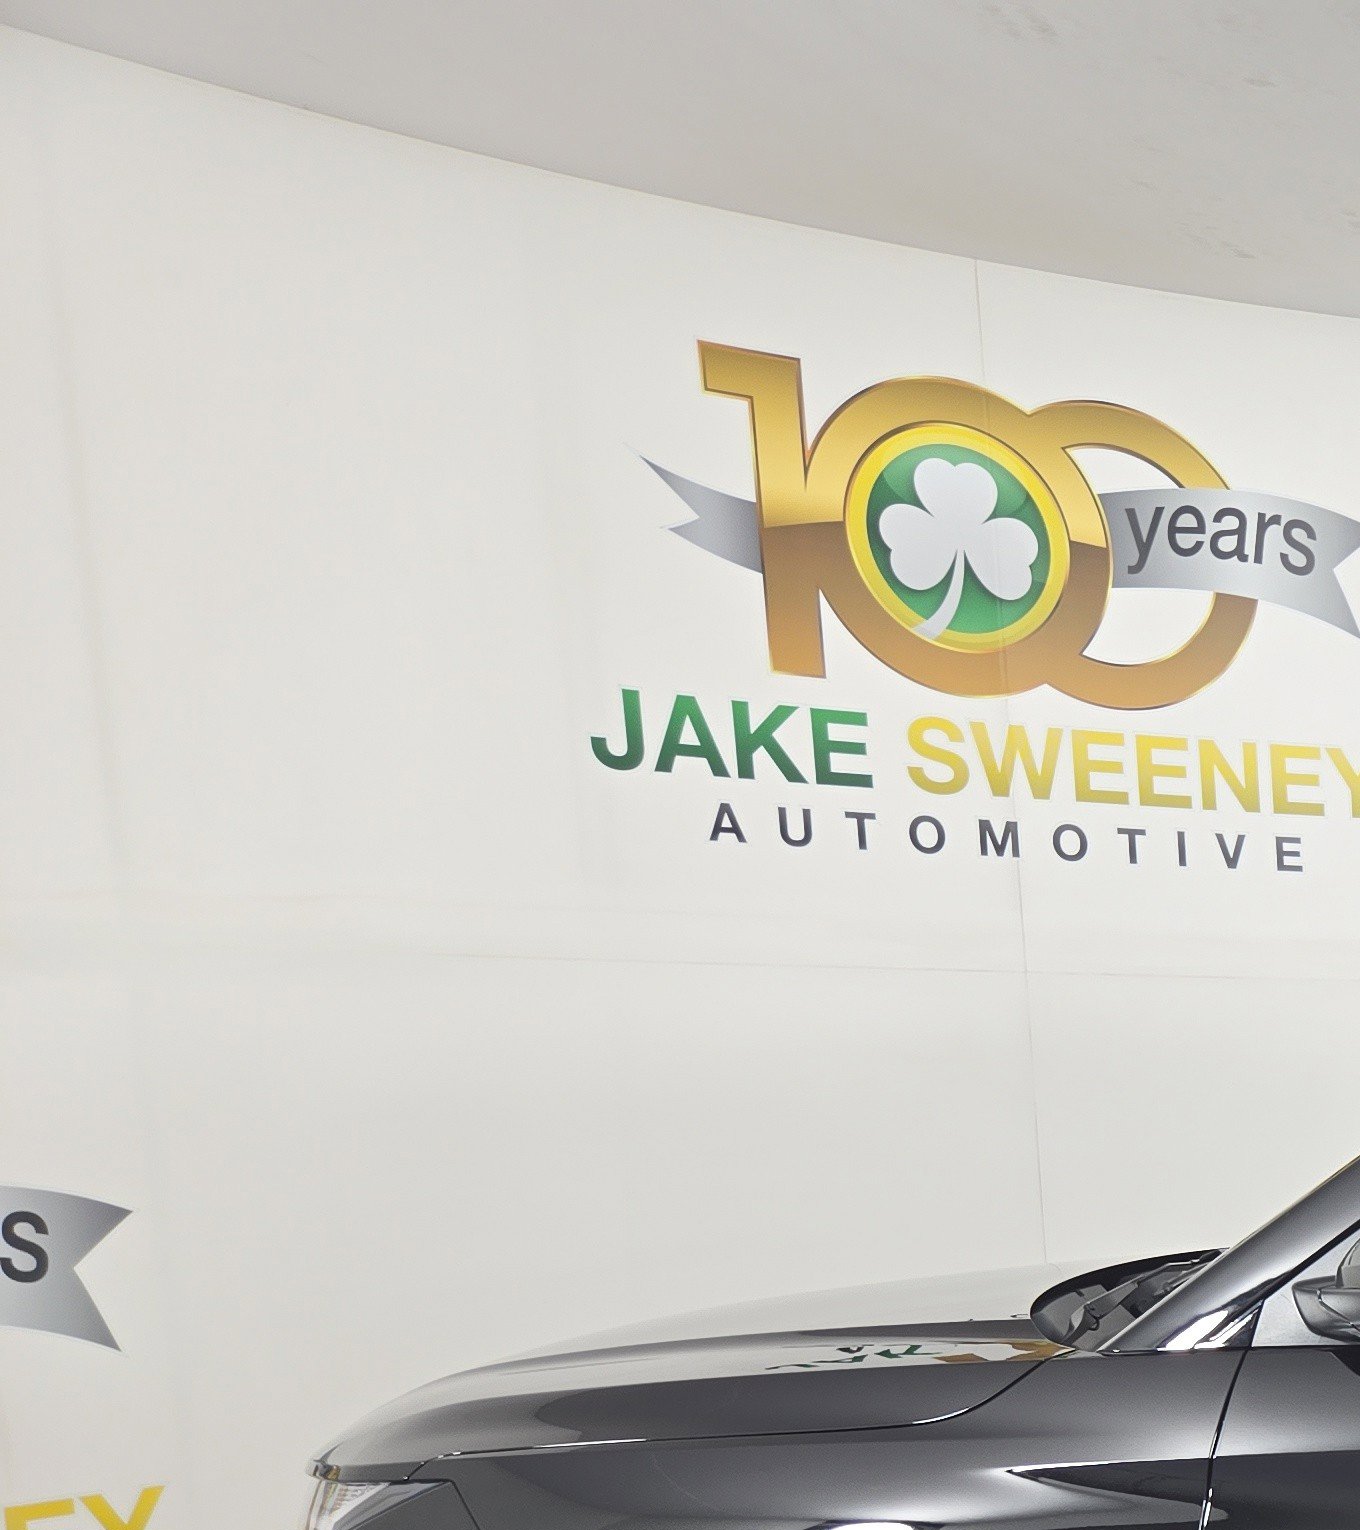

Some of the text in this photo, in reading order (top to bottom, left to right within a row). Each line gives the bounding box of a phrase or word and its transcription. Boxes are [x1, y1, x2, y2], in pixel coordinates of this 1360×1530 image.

[697, 339, 1259, 711] 100
[1126, 503, 1319, 577] years
[590, 687, 875, 789] JAKE
[709, 801, 1305, 873] AUTOMOTIVE
